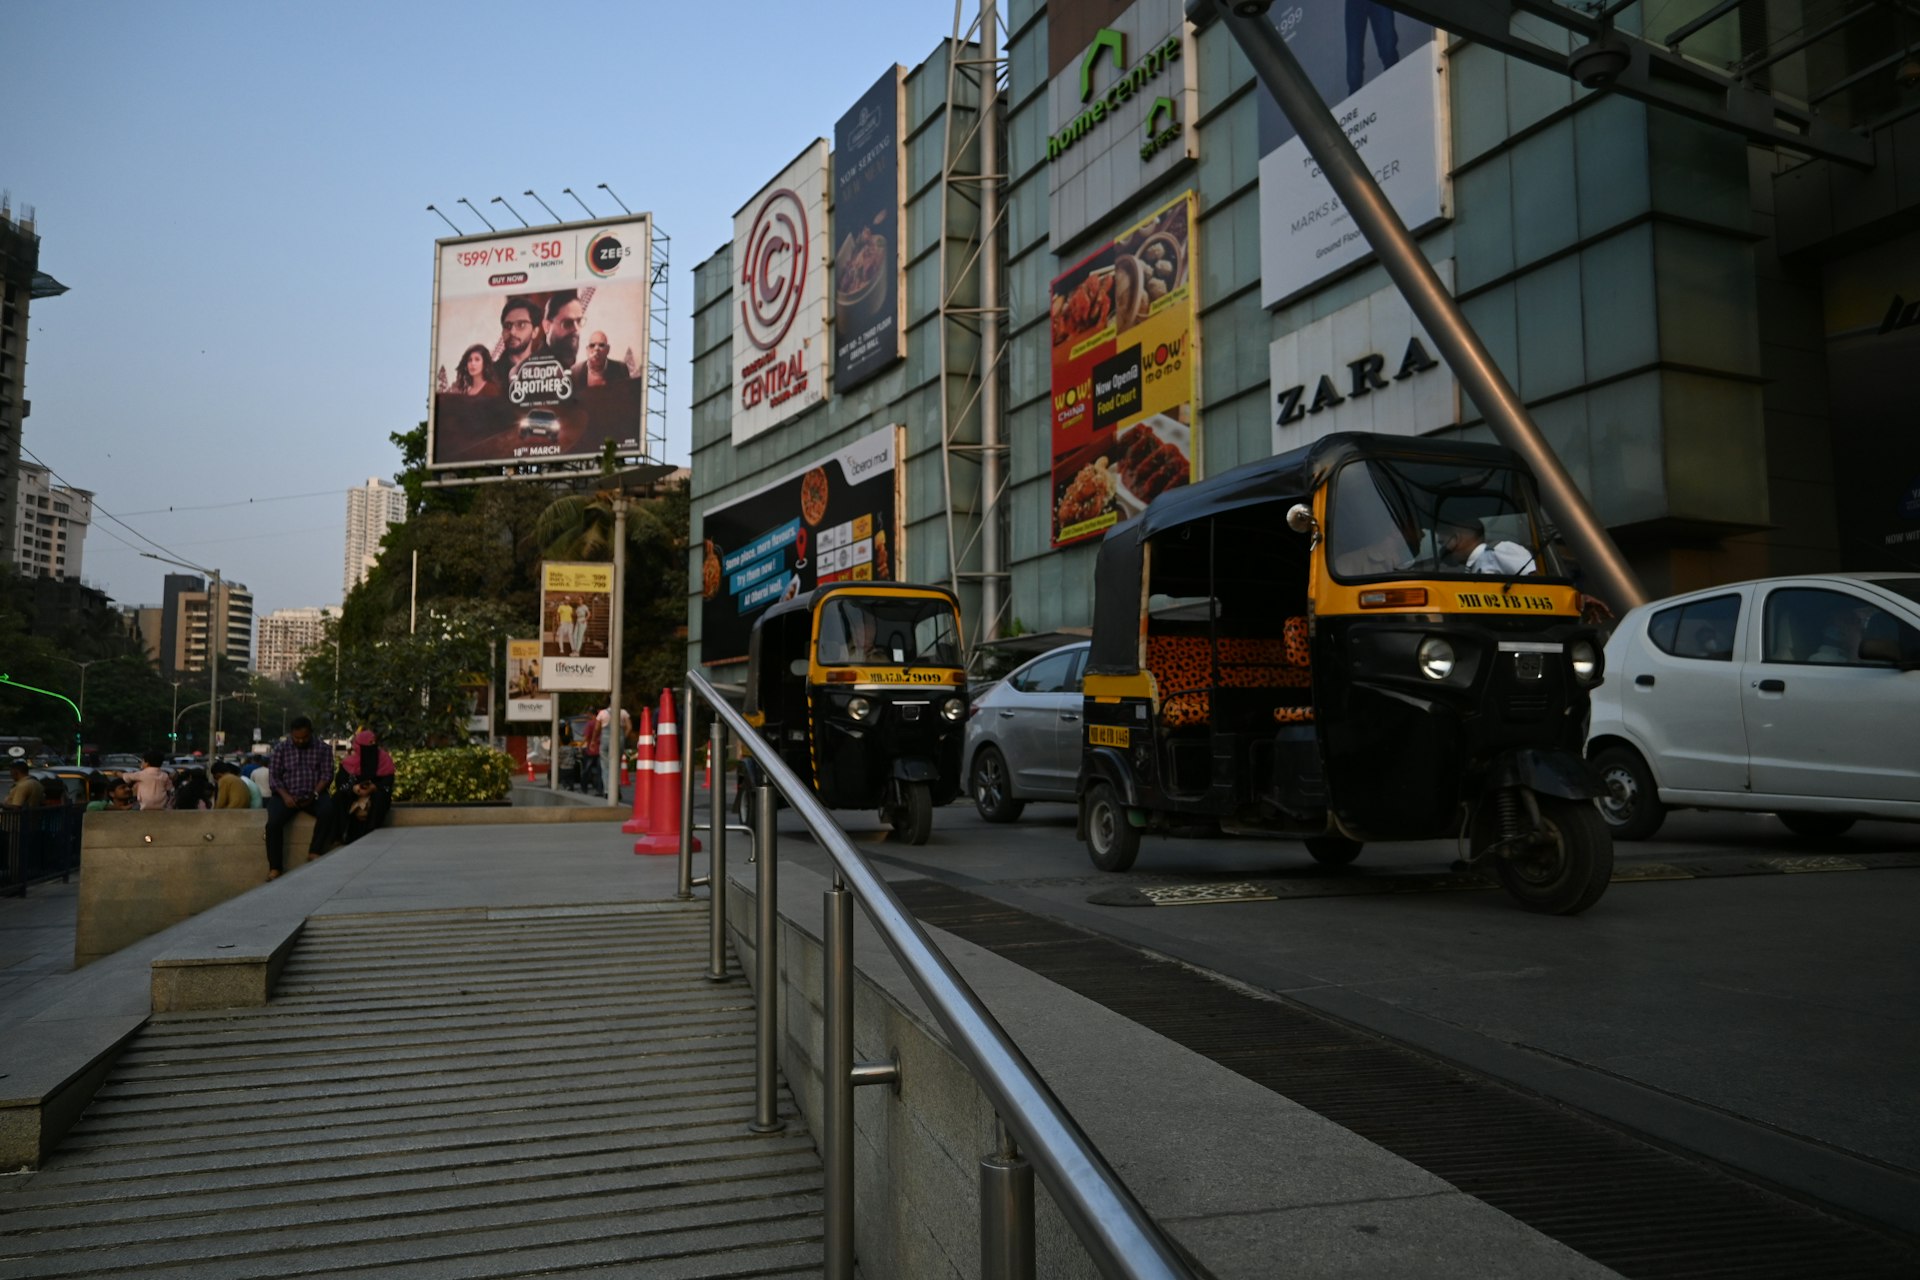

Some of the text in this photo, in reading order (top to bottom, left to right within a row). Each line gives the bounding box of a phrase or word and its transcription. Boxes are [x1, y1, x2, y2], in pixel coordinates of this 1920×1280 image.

[1047, 36, 1180, 162] homecentre
[1291, 202, 1329, 235] MARKS
[1331, 197, 1339, 211] &
[1316, 238, 1341, 258] Ground
[541, 259, 563, 268] MONTH
[491, 274, 524, 285] BUY NOW
[522, 365, 559, 379] BLOODY
[742, 350, 808, 410] CENTRAL
[1277, 336, 1439, 426] ZARA
[510, 376, 572, 403] BROTHERS
[1054, 377, 1092, 411] WOW!
[1095, 379, 1111, 397] Now
[1097, 386, 1137, 416] Food Court
[530, 446, 560, 455] MARCH
[1885, 533, 1903, 544] NOW
[1458, 594, 1481, 607] MH
[1484, 594, 1500, 607] 02
[1523, 596, 1553, 610] 1445
[555, 661, 596, 674] lifestyle
[518, 702, 543, 711] lifestyle
